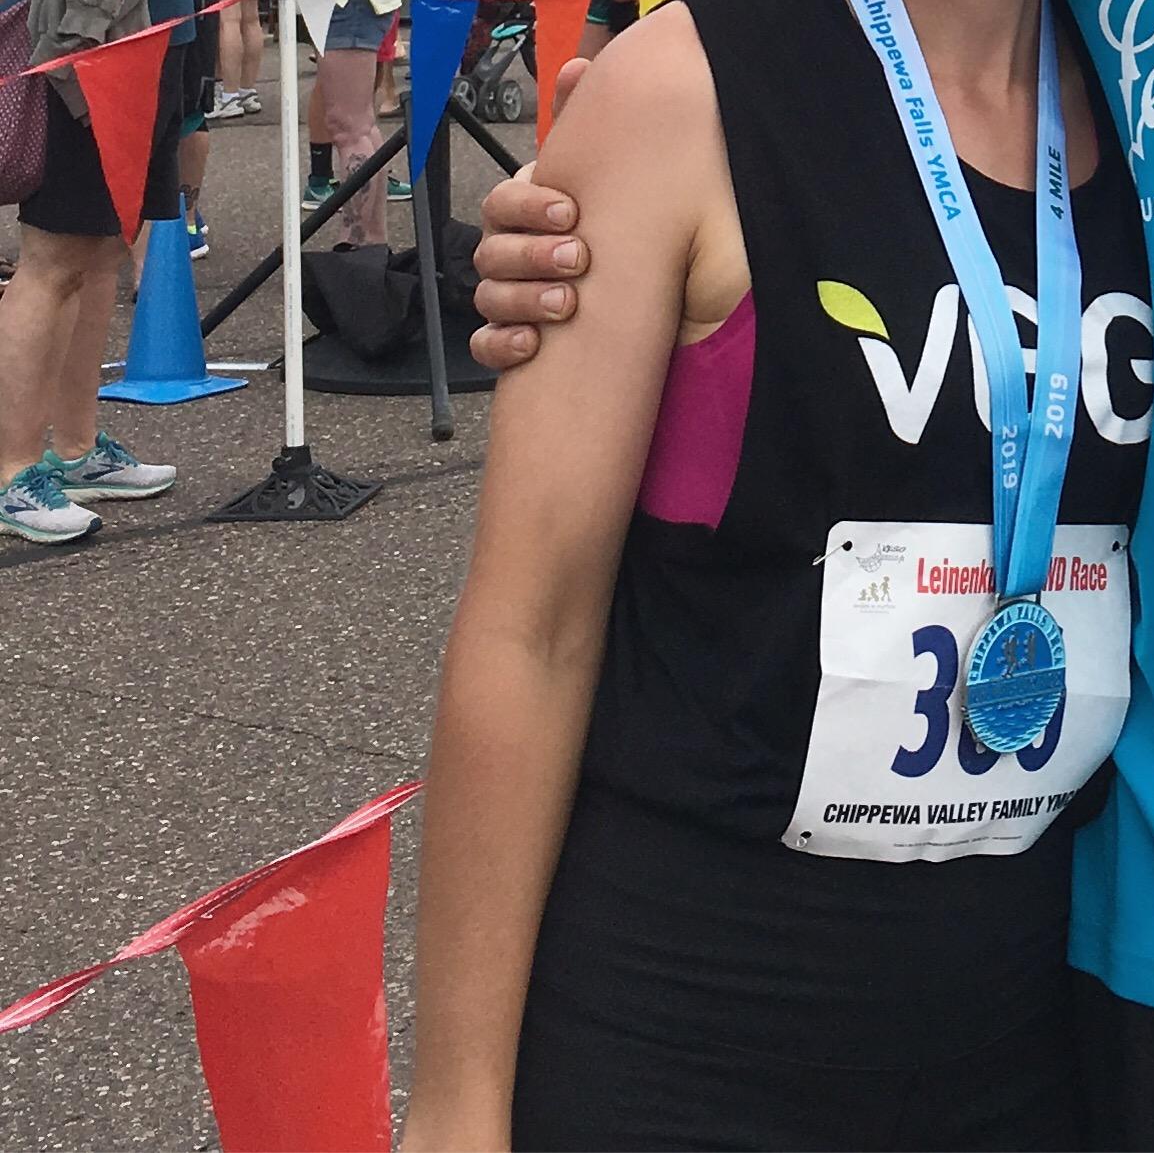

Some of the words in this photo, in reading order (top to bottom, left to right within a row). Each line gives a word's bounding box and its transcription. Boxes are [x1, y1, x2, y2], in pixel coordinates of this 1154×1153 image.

[904, 96, 934, 148] Falls
[926, 153, 962, 221] YMCA
[1048, 145, 1062, 201] MILE
[1050, 203, 1064, 220] 4
[1043, 373, 1069, 440] 2019
[1000, 425, 1019, 489] 2019
[1069, 556, 1108, 591] Race
[823, 803, 921, 825] CHIPPEWA
[927, 802, 988, 824] VALLEY
[990, 796, 1055, 820] FAMILY
